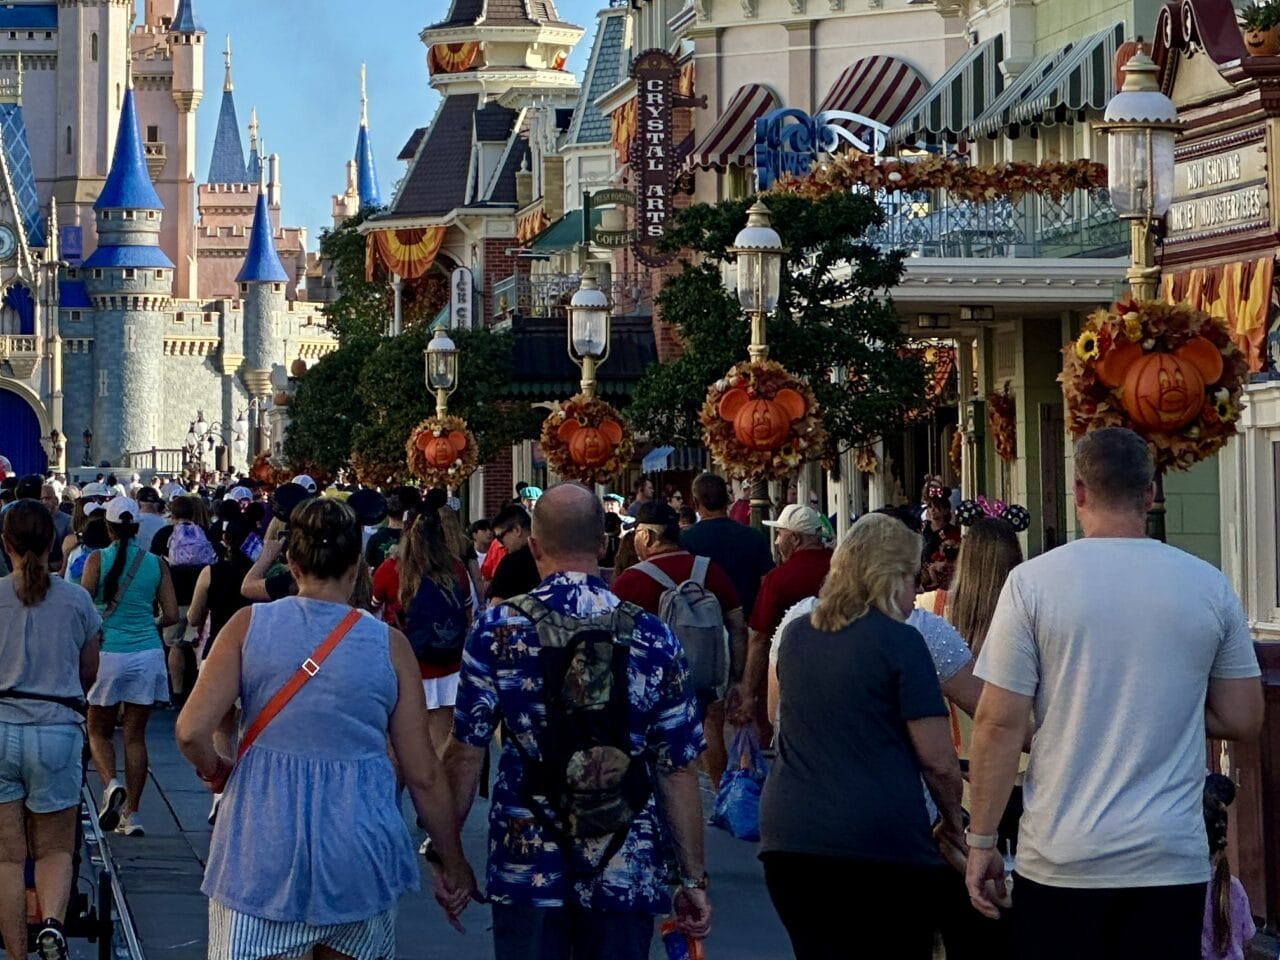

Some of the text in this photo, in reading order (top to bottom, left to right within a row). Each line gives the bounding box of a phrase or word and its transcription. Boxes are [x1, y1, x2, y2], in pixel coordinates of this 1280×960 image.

[646, 79, 665, 237] CRYSTAL ARTS
[1187, 154, 1240, 190] NOW SHOWING
[1171, 203, 1197, 232] MICKEY
[456, 270, 467, 304] ICE
